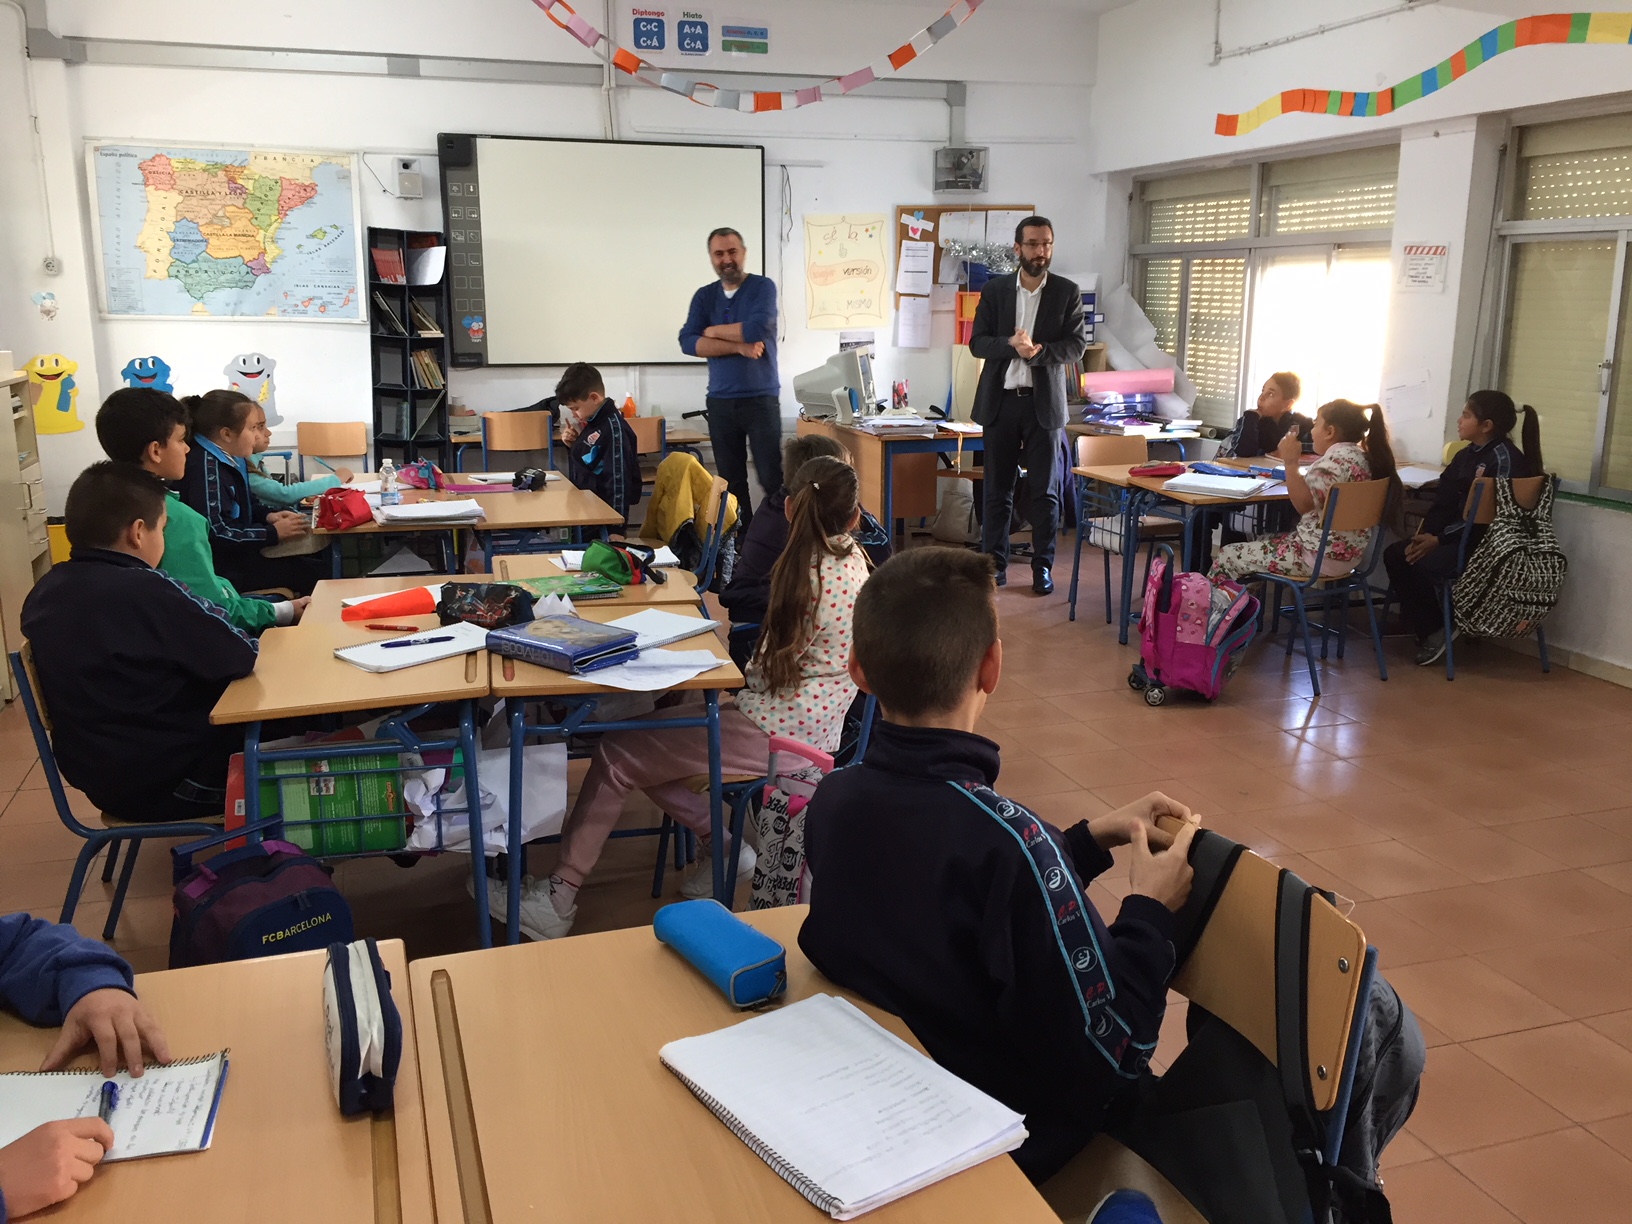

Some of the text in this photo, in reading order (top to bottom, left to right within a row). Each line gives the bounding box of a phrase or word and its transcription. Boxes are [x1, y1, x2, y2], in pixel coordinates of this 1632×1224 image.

[632, 8, 665, 18] Diptongo
[640, 22, 658, 31] C+C
[684, 24, 702, 34] A+A
[152, 196, 168, 274] PORTUGAL
[842, 265, 872, 276] versión
[846, 298, 872, 309] MISMO
[1026, 836, 1043, 848] Carlos
[1058, 915, 1075, 925] Carlos
[1087, 998, 1106, 1008] Carlos
